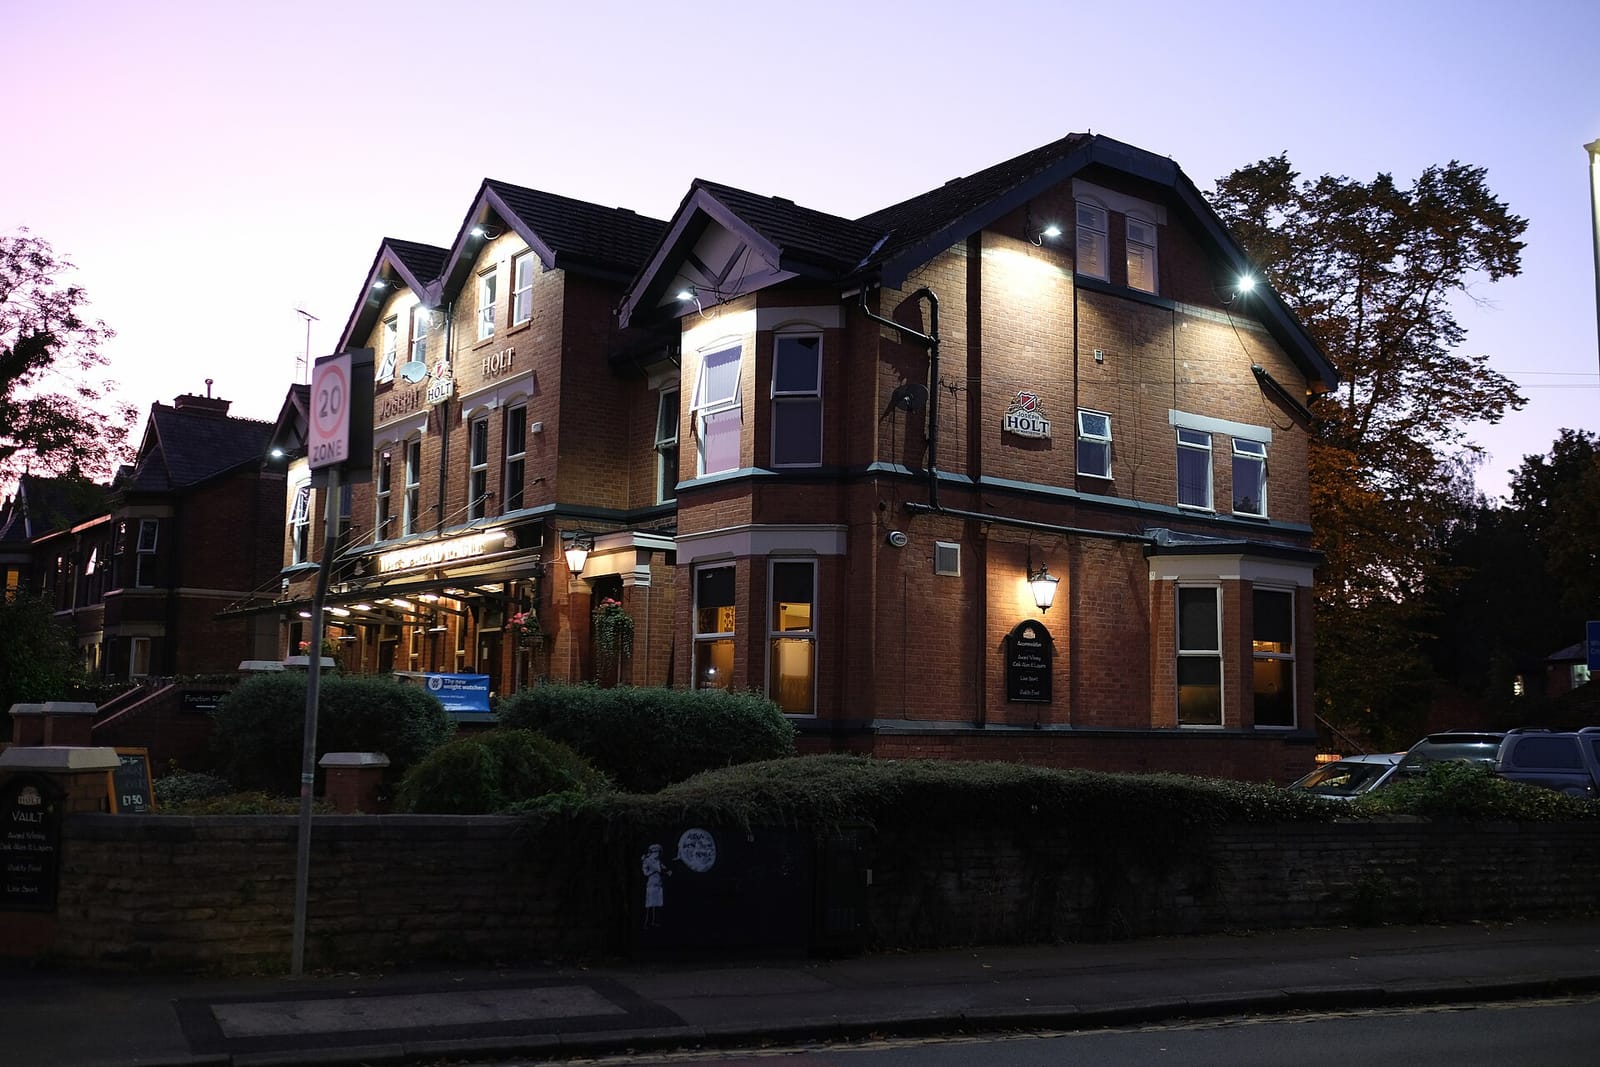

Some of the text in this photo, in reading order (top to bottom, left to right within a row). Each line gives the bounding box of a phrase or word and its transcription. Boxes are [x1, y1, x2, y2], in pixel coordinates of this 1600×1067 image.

[482, 347, 515, 377] HOLT
[320, 386, 341, 418] 20
[427, 382, 451, 401] HOLT
[1007, 416, 1049, 433] HOLT
[313, 439, 343, 463] ZONE
[11, 809, 45, 823] VAULT
